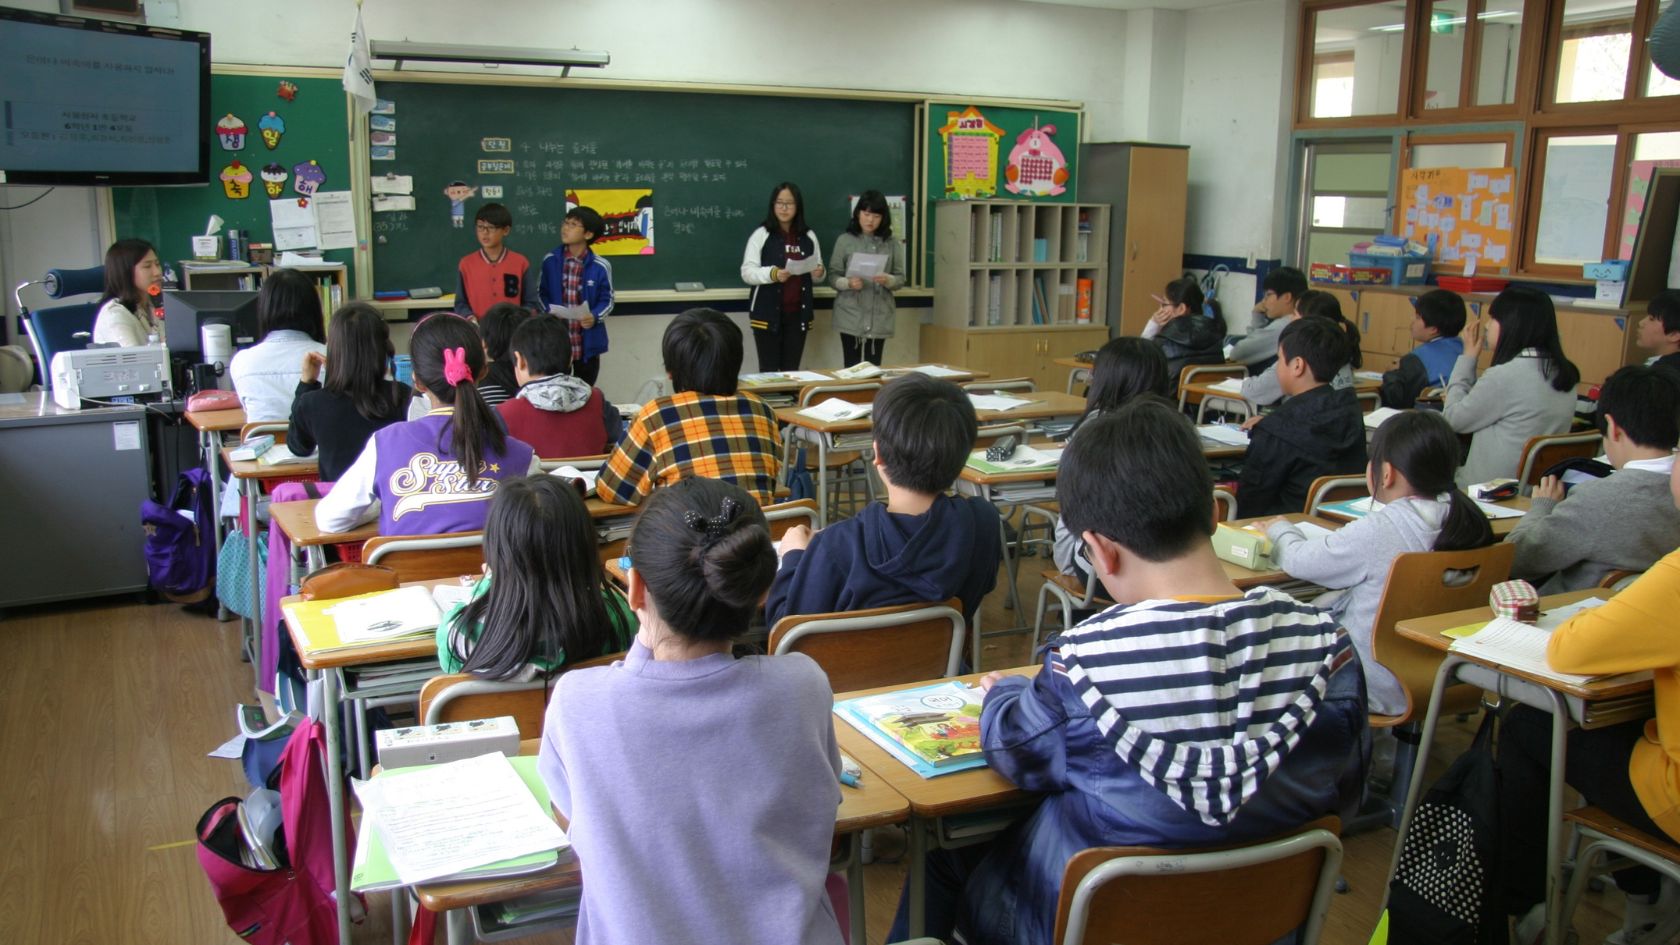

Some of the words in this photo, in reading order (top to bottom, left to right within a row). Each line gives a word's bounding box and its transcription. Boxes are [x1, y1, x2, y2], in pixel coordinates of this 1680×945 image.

[263, 129, 279, 147] 일
[298, 180, 313, 195] 해
[504, 273, 520, 298] B
